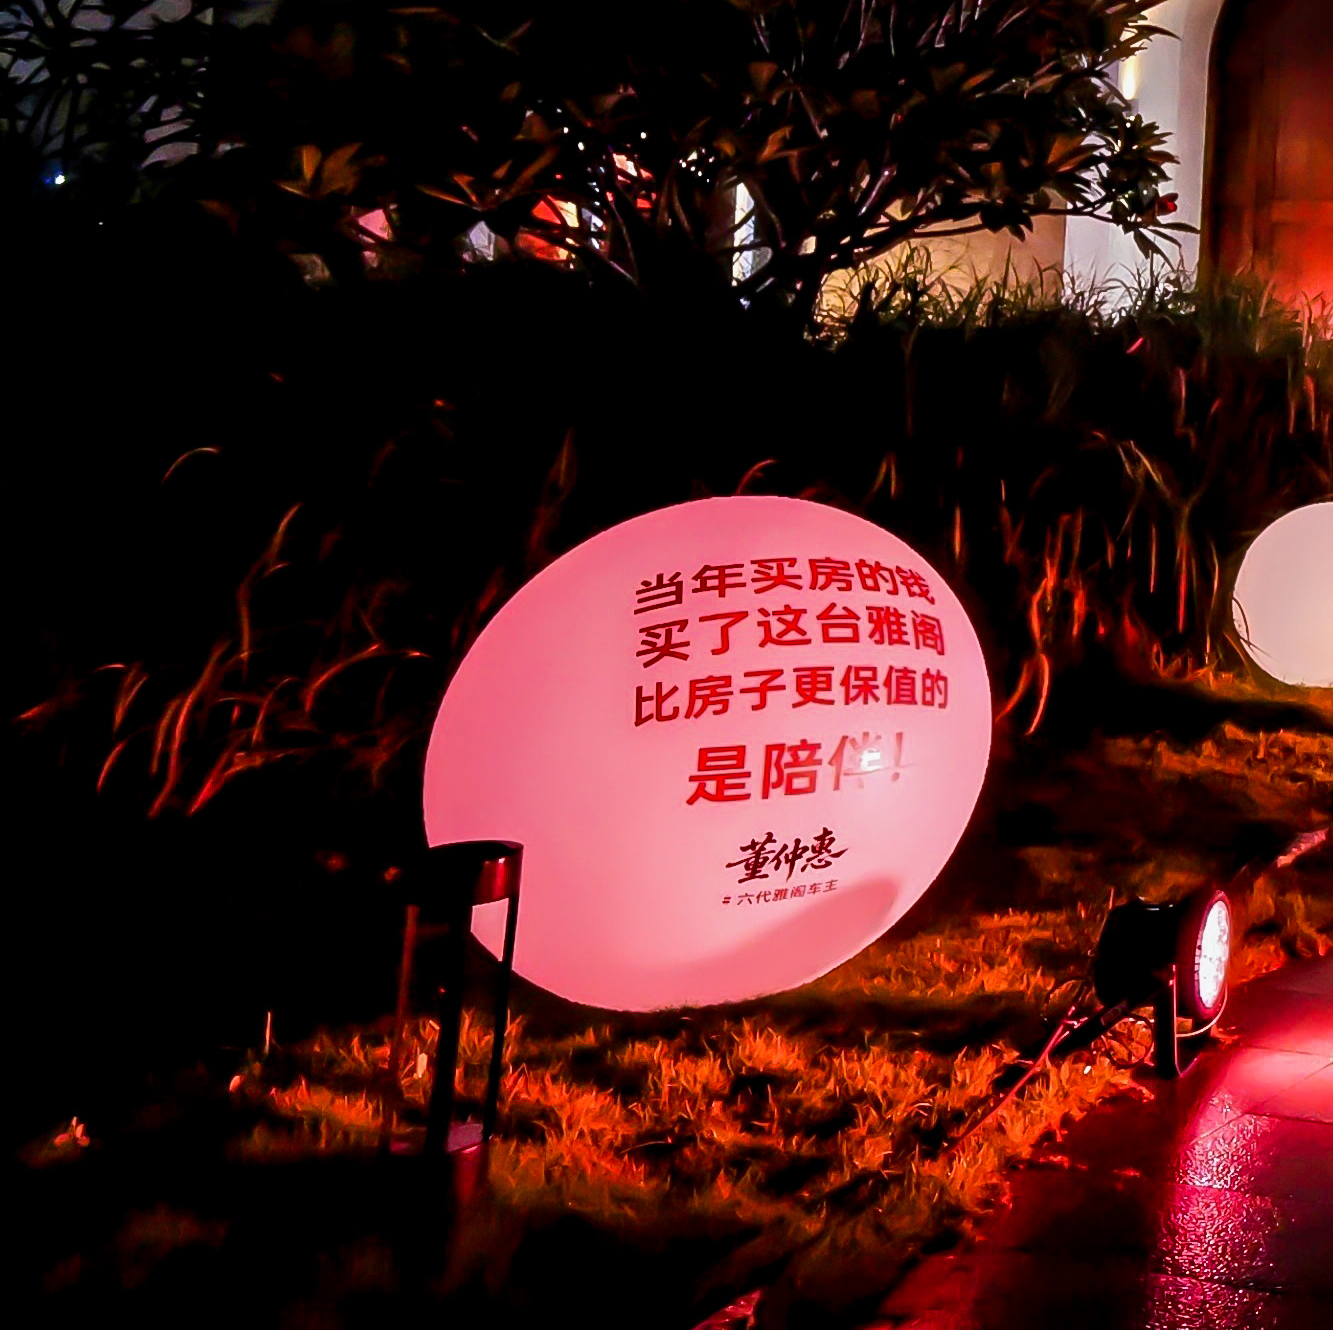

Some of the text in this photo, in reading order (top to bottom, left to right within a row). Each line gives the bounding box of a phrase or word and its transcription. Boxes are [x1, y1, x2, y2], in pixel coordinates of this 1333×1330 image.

[634, 557, 936, 615] 当年买房的钱
[634, 602, 946, 669] 买了这台雅阁
[634, 664, 949, 728] 比房子更保值的
